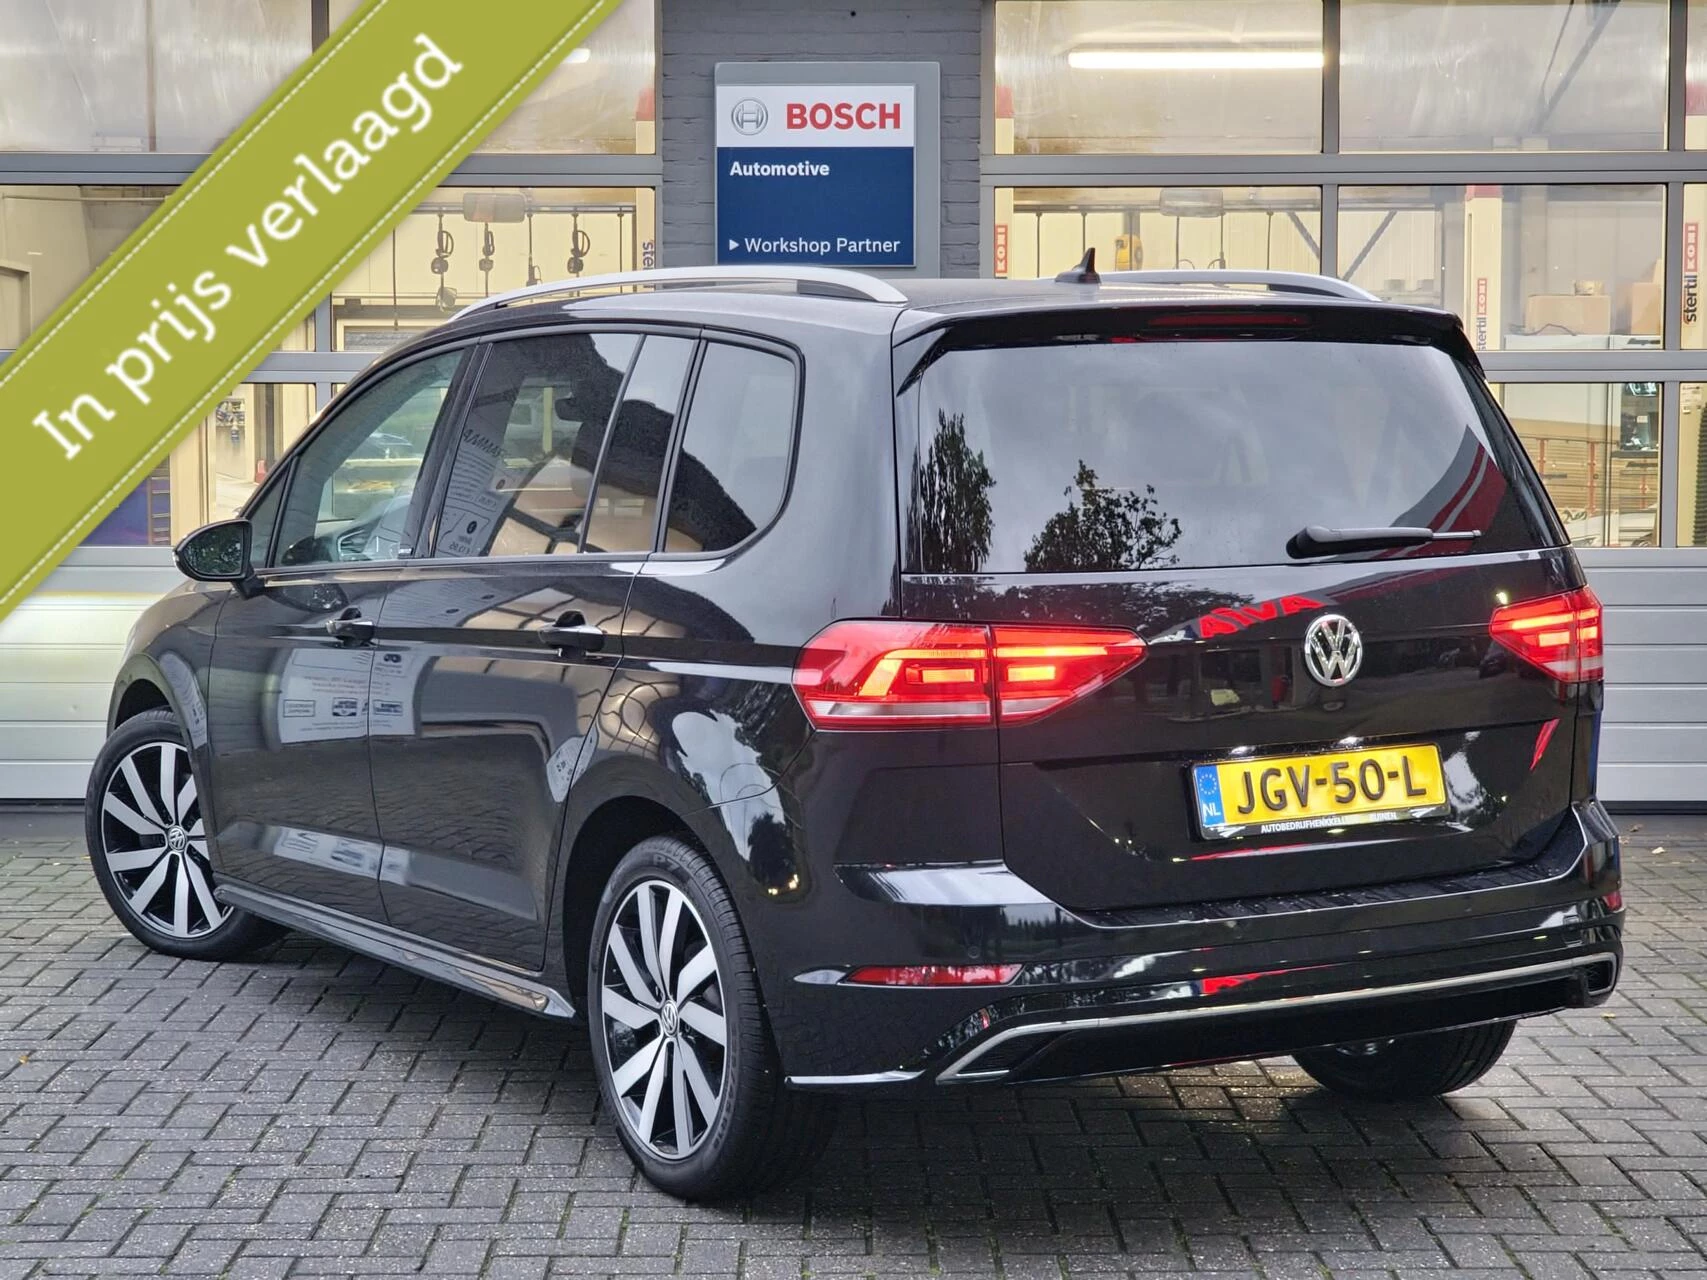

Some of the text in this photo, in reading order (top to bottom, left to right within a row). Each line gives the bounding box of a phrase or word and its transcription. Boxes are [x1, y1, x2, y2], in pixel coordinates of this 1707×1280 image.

[786, 102, 901, 130] BOSCH
[729, 160, 830, 177] Automotive
[744, 237, 901, 256] Workshop Partner
[1684, 275, 1698, 324] stertil
[1237, 755, 1427, 815] JGV-50-L
[1202, 803, 1221, 818] NL
